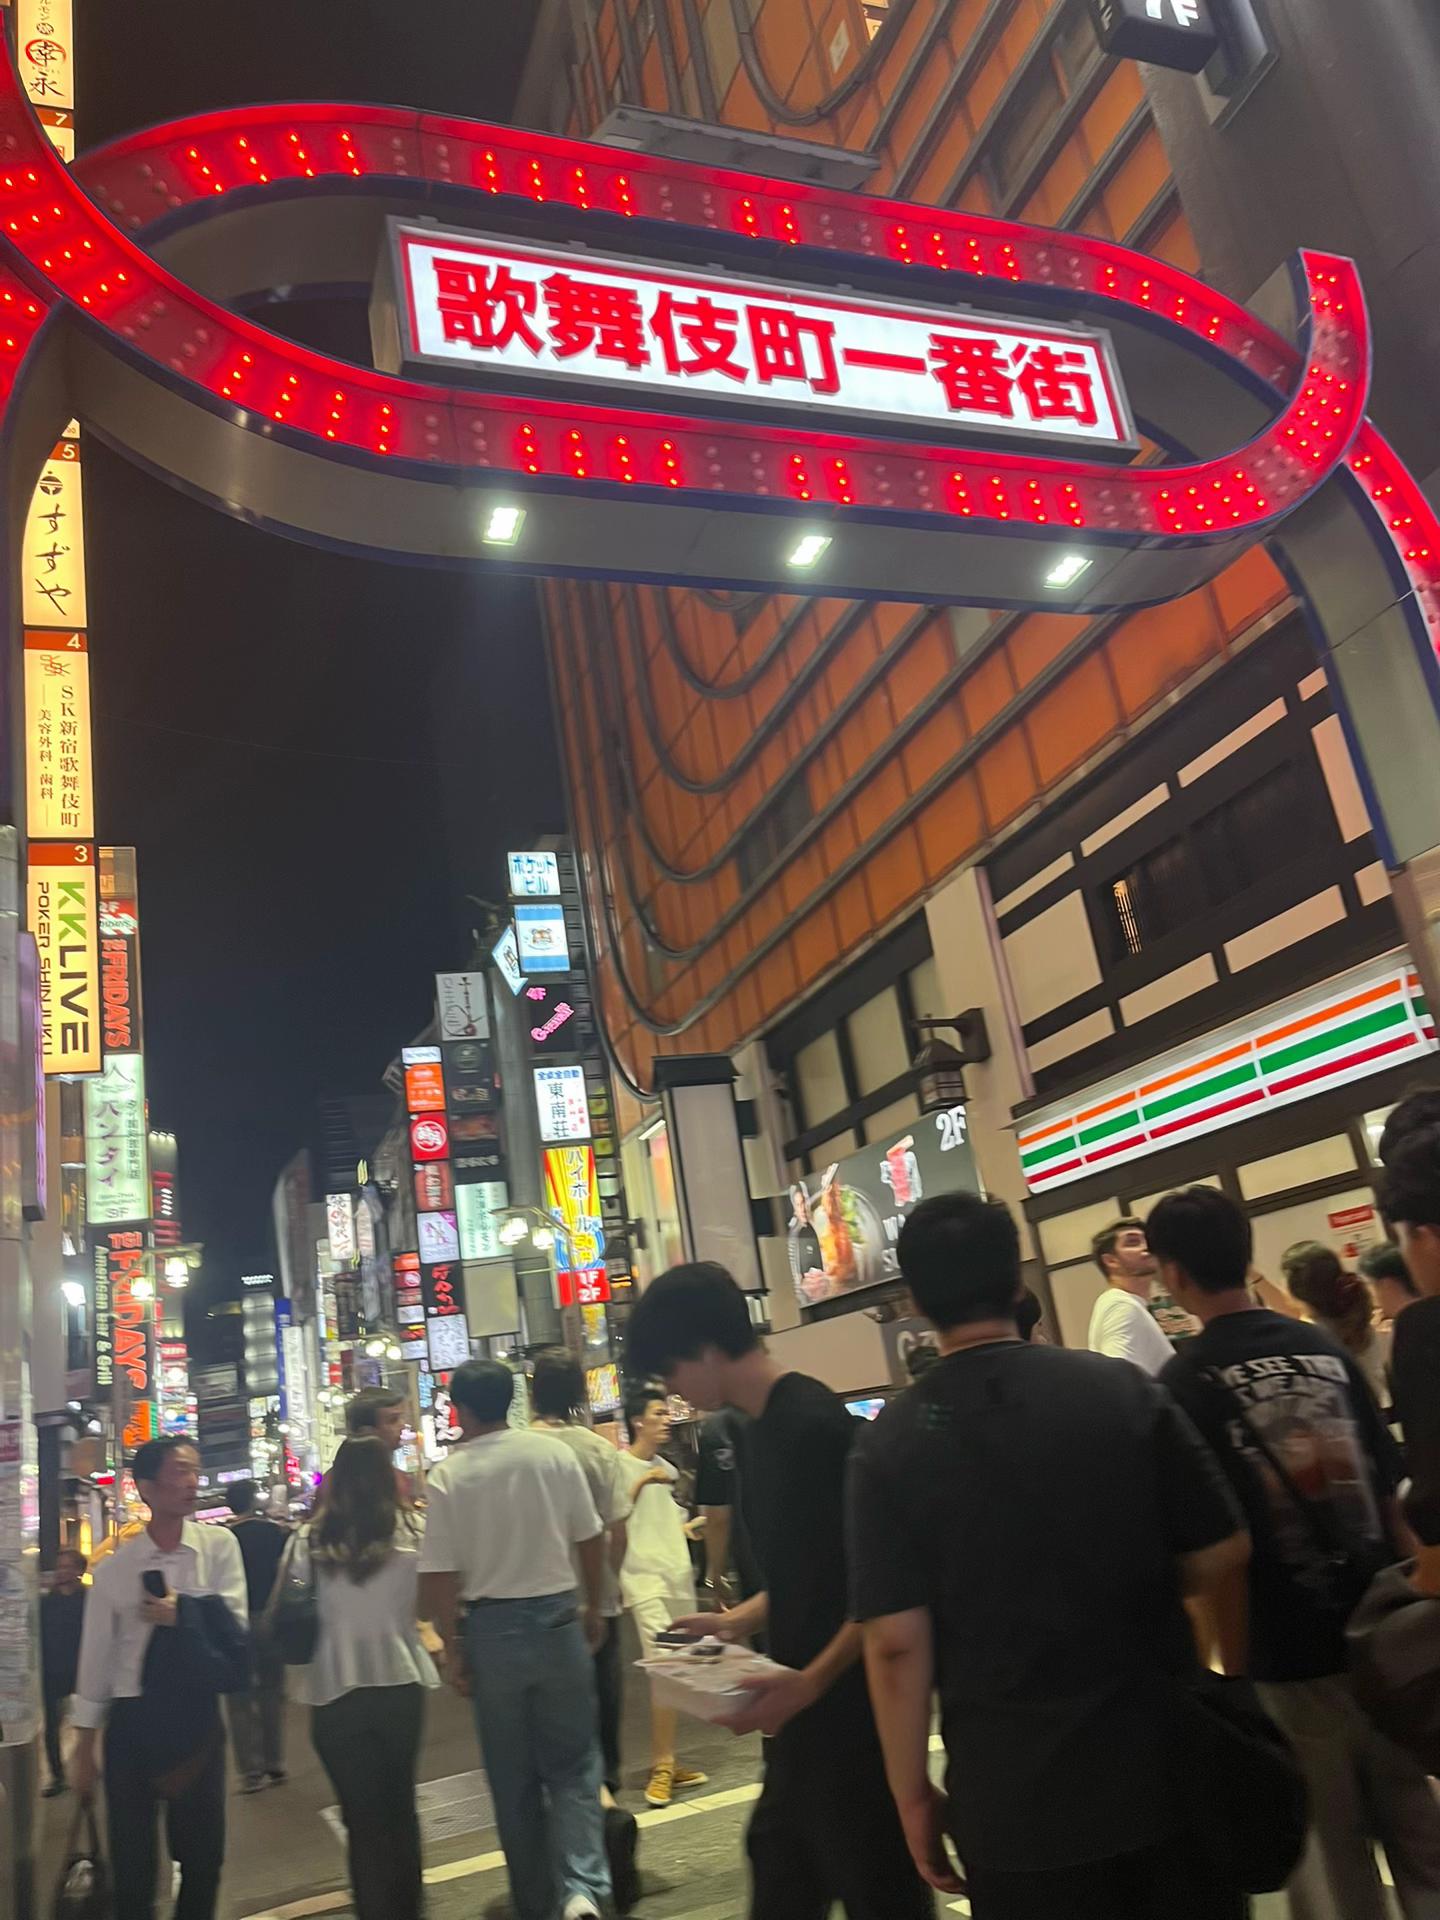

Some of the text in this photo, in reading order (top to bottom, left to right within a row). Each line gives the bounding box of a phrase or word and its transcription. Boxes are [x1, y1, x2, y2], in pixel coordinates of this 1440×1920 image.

[55, 112, 68, 126] 7
[431, 256, 1099, 427] 歌舞伎町一番街
[62, 444, 76, 460] 5
[35, 503, 73, 617] すずや
[66, 633, 81, 649] 4
[59, 685, 81, 829] SK新宿歌舞伎町
[74, 845, 89, 864] 3
[37, 881, 51, 949] POKER
[57, 881, 90, 1055] KKLIVE
[936, 1105, 967, 1151] 2F
[566, 1150, 591, 1233] ハイボール
[95, 1246, 111, 1310] American
[578, 1270, 600, 1284] 1F
[578, 1287, 601, 1302] 2F
[96, 1340, 112, 1352] &
[97, 1354, 113, 1386] Grill
